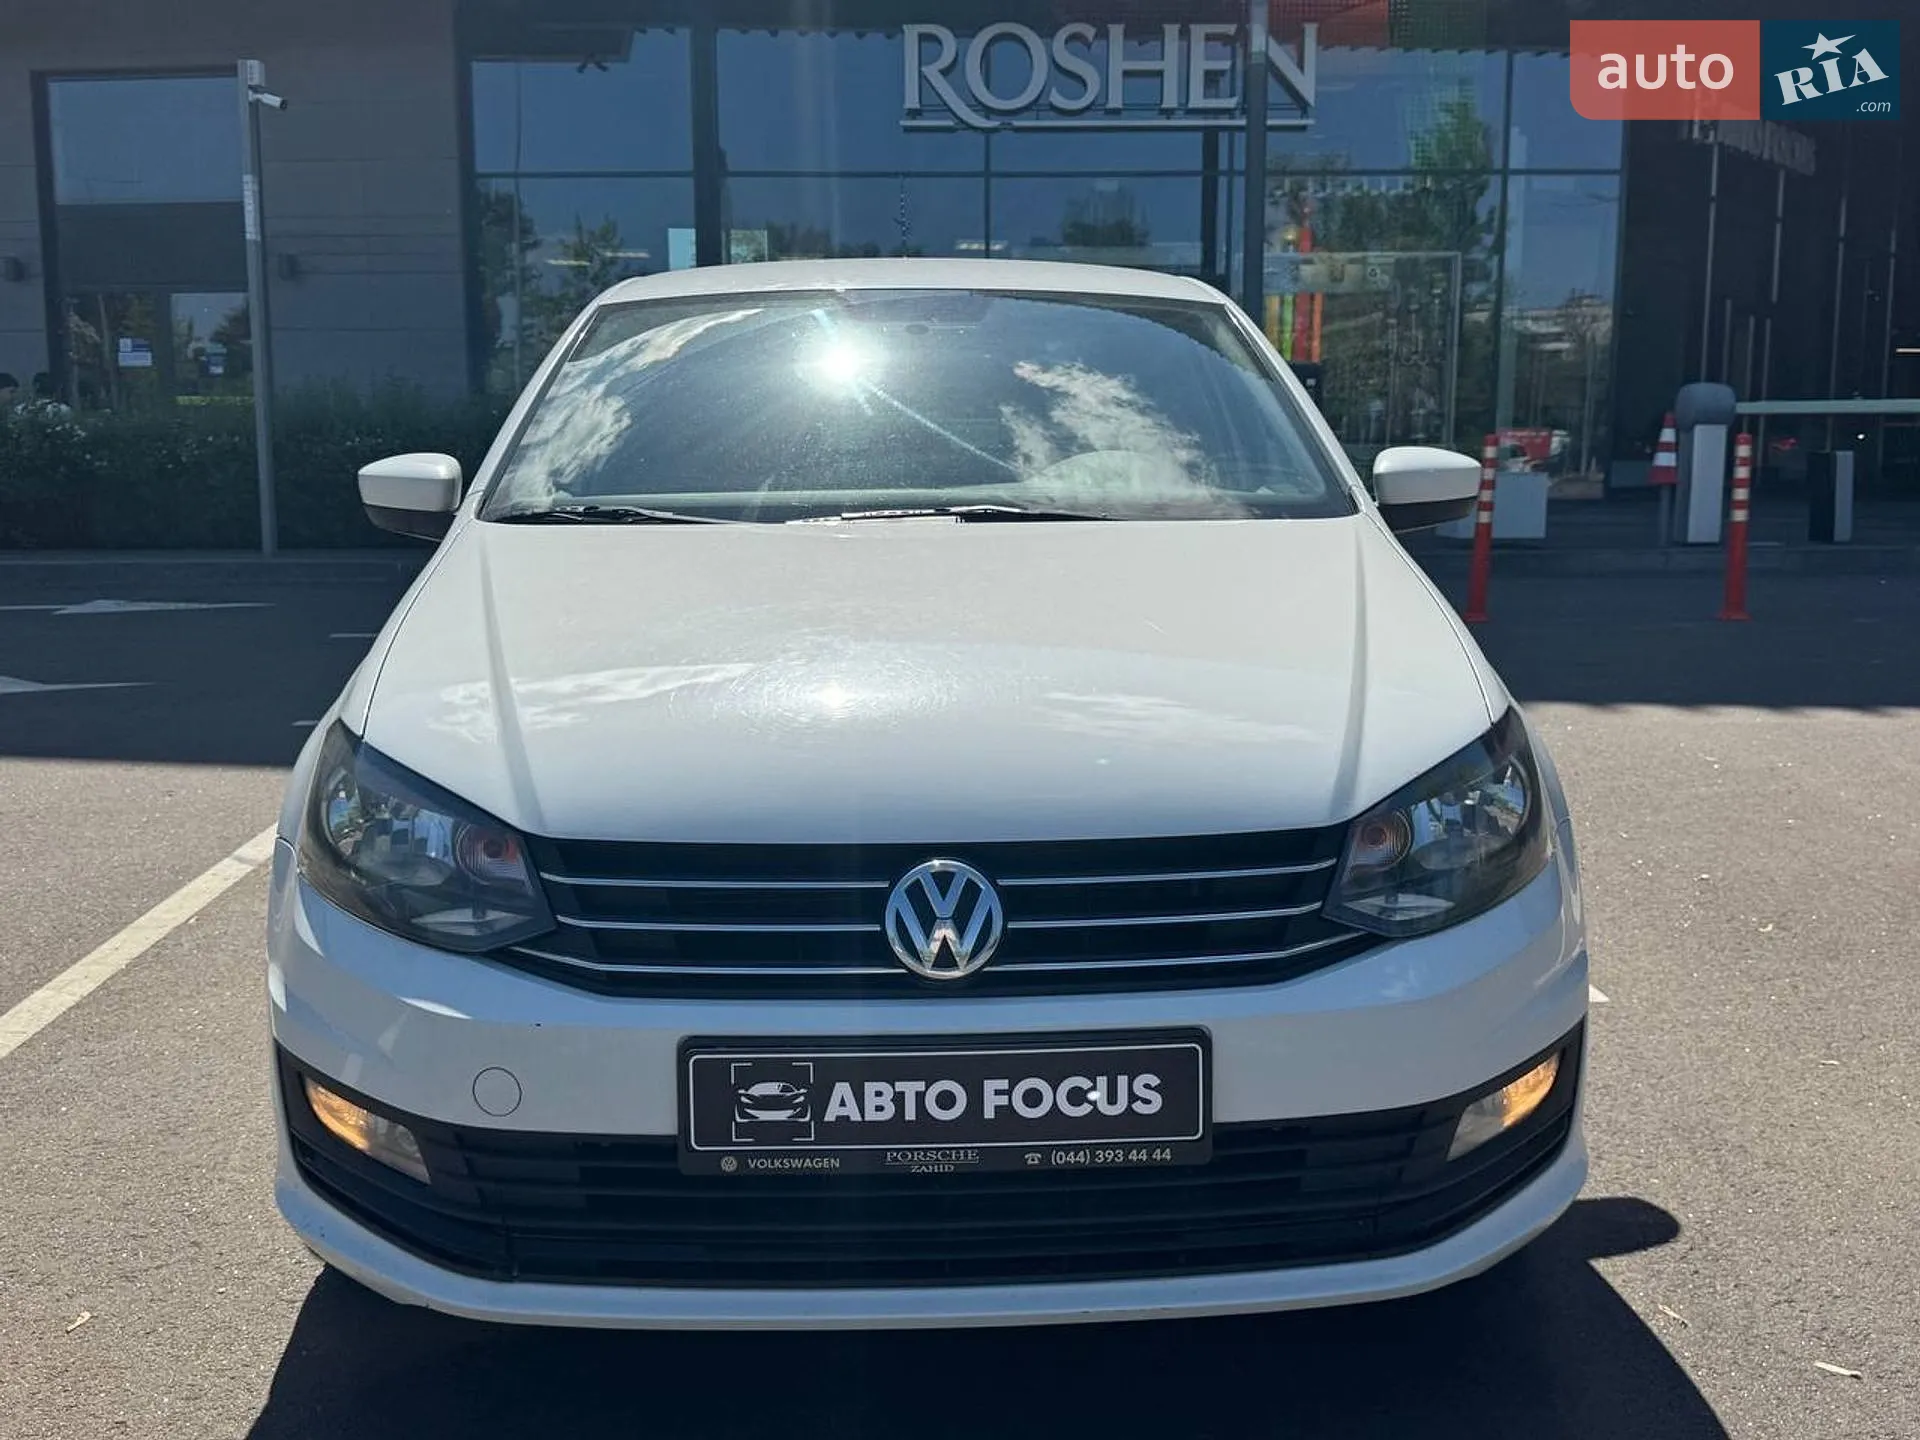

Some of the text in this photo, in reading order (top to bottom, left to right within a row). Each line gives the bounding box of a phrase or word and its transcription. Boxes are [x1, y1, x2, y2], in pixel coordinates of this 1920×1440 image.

[902, 22, 1319, 129] ROSHEN
[823, 1073, 1163, 1122] АВТО FOCUS
[747, 1157, 841, 1170] VOLKSWAGEN
[885, 1150, 980, 1162] PORSCHE
[1051, 1147, 1172, 1166] (044) 393 44 44
[911, 1164, 955, 1173] ZAHID
